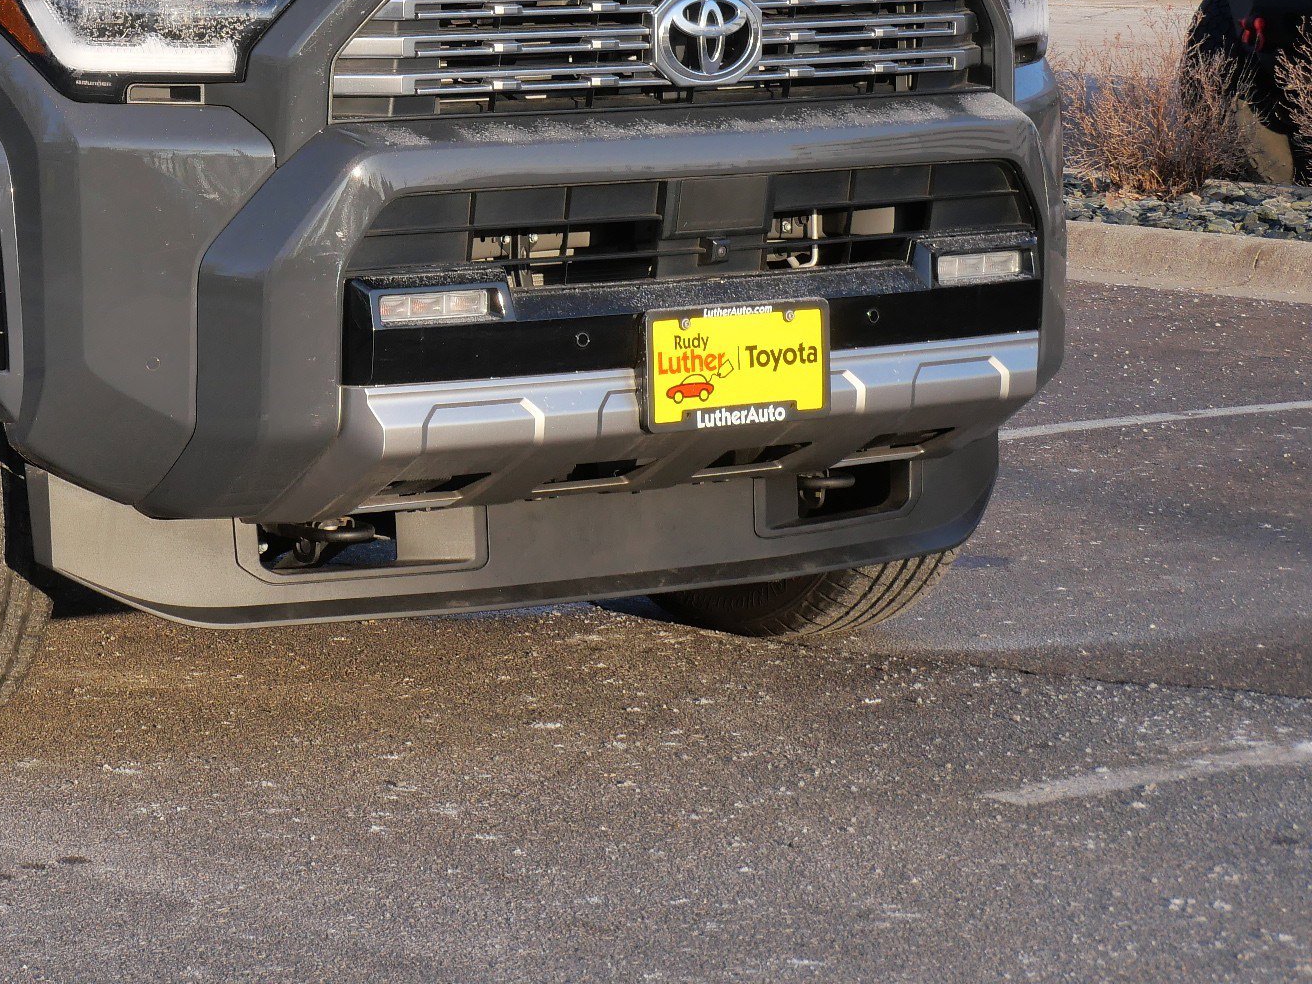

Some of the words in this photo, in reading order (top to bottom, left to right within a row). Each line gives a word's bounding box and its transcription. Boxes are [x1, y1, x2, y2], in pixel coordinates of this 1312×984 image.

[703, 305, 773, 318] LutherAuto.com
[674, 333, 709, 350] Rudy
[657, 349, 726, 376] Luther
[745, 342, 818, 372] Toyota
[696, 404, 786, 429] LutherAuto
